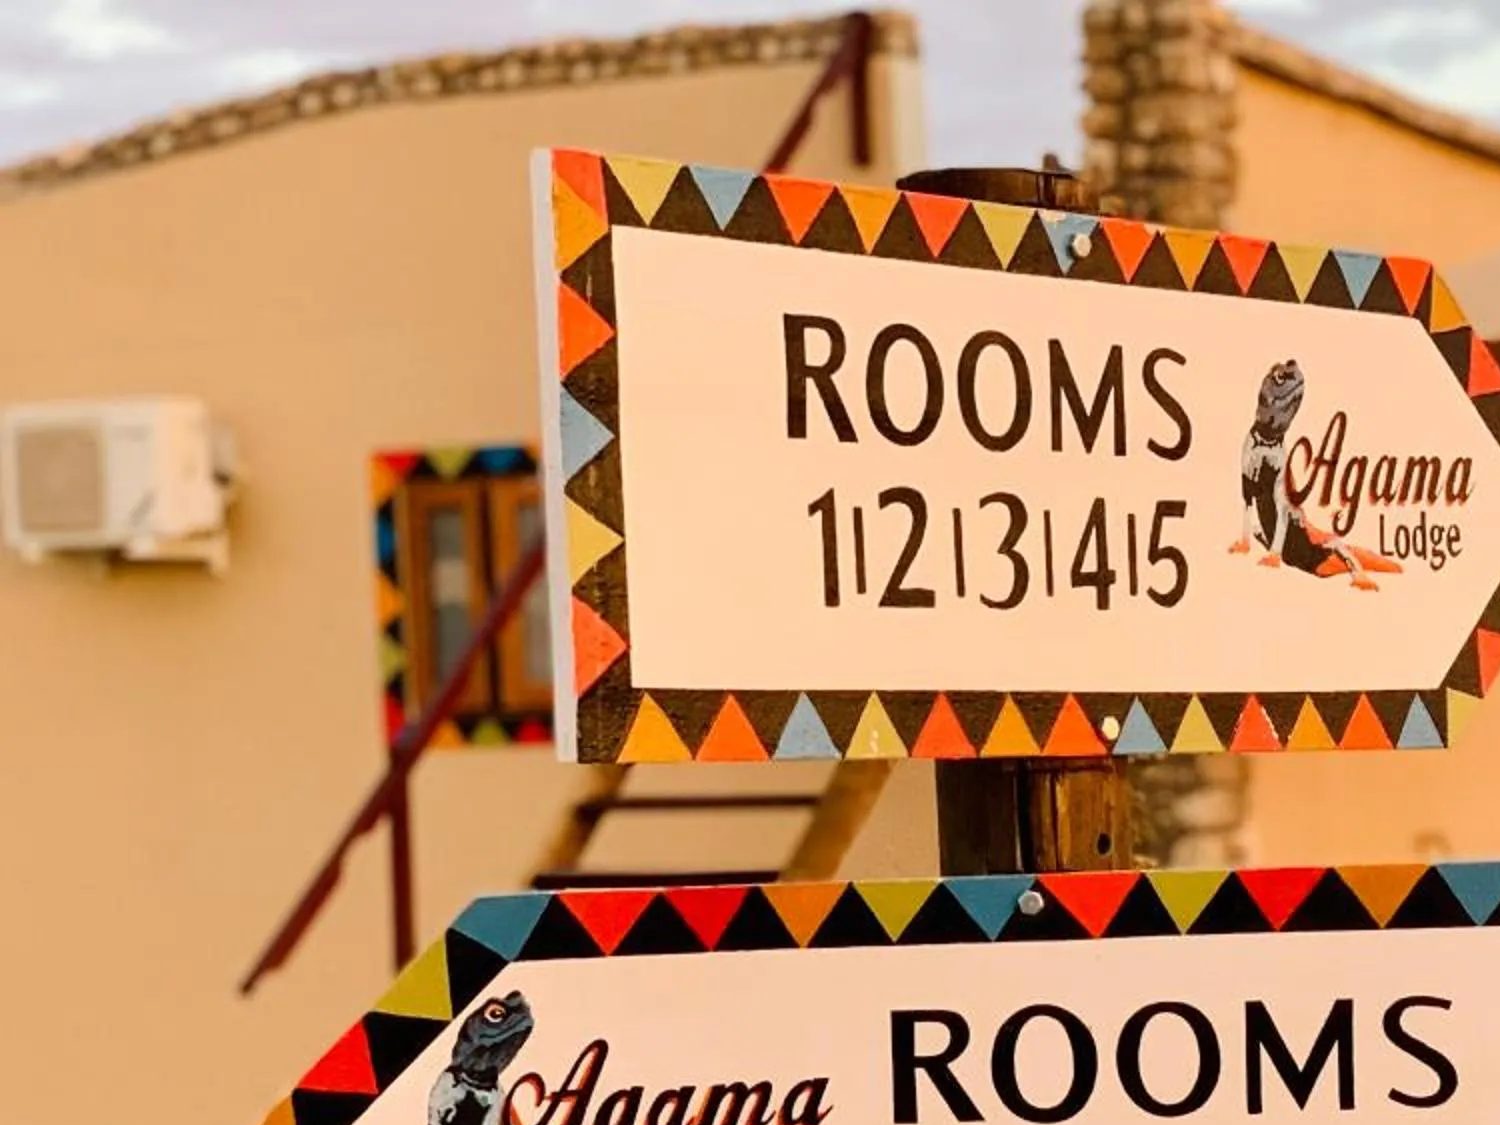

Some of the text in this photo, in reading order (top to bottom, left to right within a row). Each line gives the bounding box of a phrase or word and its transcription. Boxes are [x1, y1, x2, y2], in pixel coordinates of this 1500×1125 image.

[783, 314, 1192, 461] ROOMS
[1286, 411, 1475, 535] Agama
[1379, 514, 1462, 571] Lodge
